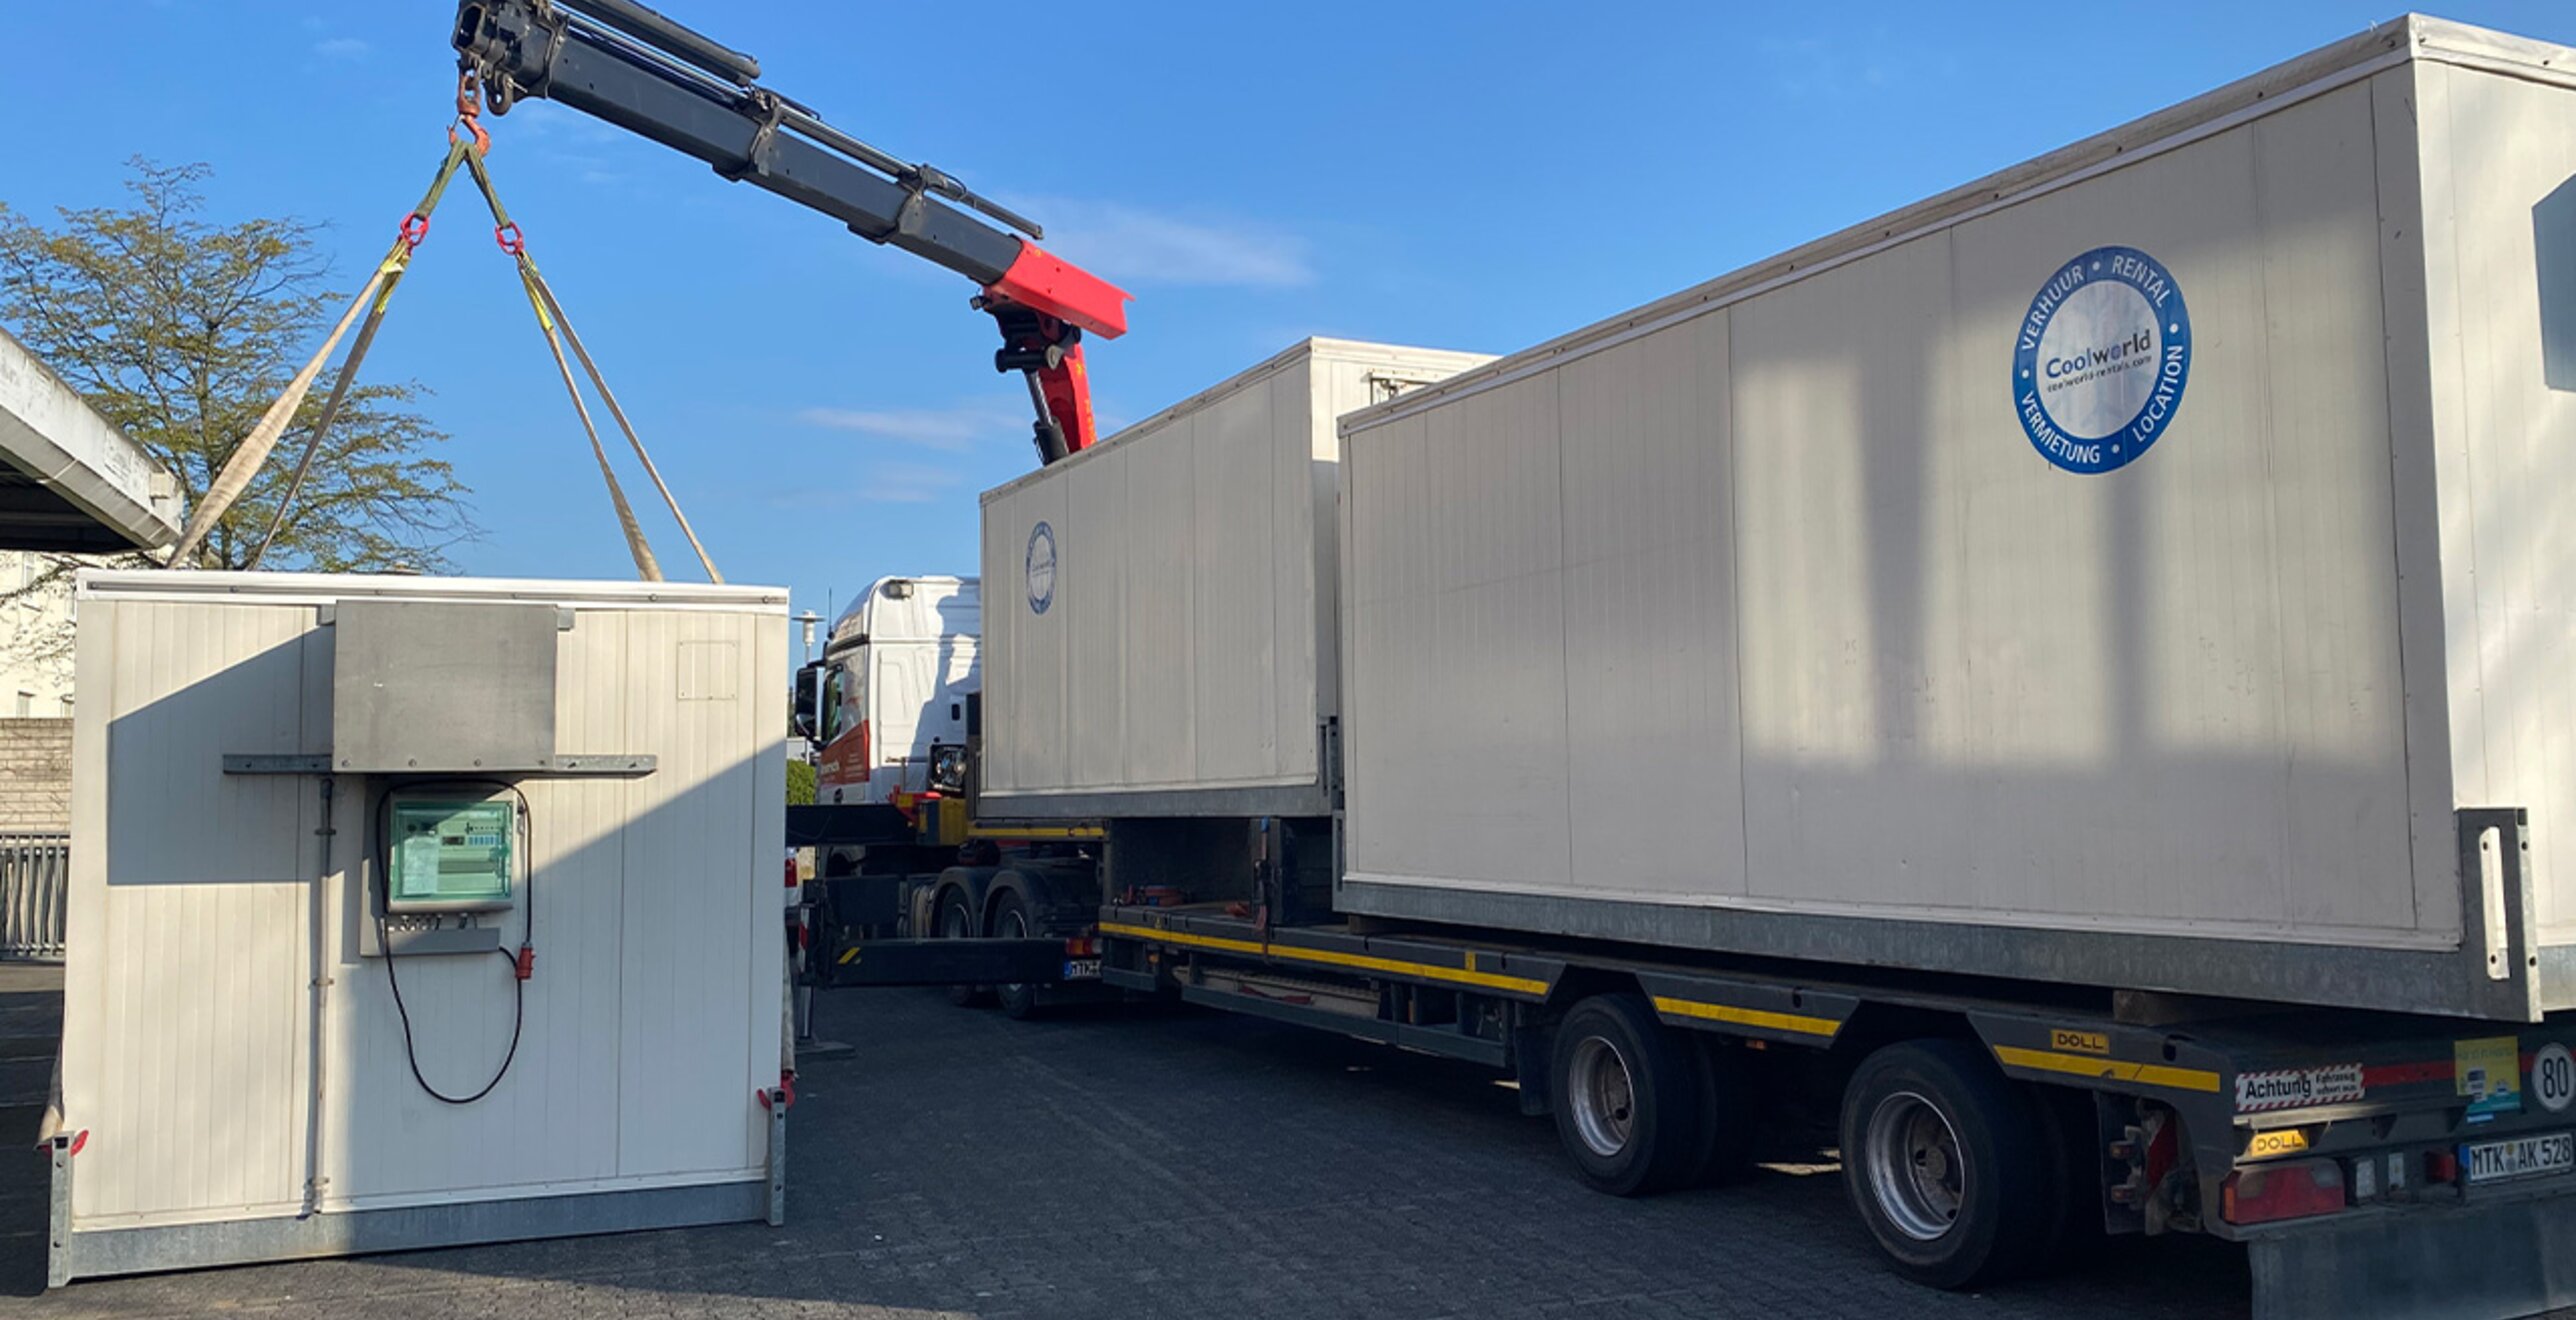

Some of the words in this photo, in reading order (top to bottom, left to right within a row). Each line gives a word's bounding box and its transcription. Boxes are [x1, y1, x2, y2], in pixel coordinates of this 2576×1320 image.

[2112, 255, 2171, 308] RENTAL
[2022, 265, 2084, 351] VERHUUR
[2046, 328, 2151, 378] Coolworld
[2132, 345, 2183, 442] LOCATION
[2022, 390, 2100, 463] VERMIETUNG
[2057, 1032, 2104, 1049] DOLL
[2245, 1078, 2311, 1099] Achtung
[2543, 1057, 2568, 1098] 80
[2255, 1135, 2303, 1151] DOLL
[2471, 1145, 2504, 1175] MTK
[2519, 1141, 2538, 1169] AK
[2541, 1137, 2571, 1166] 528
